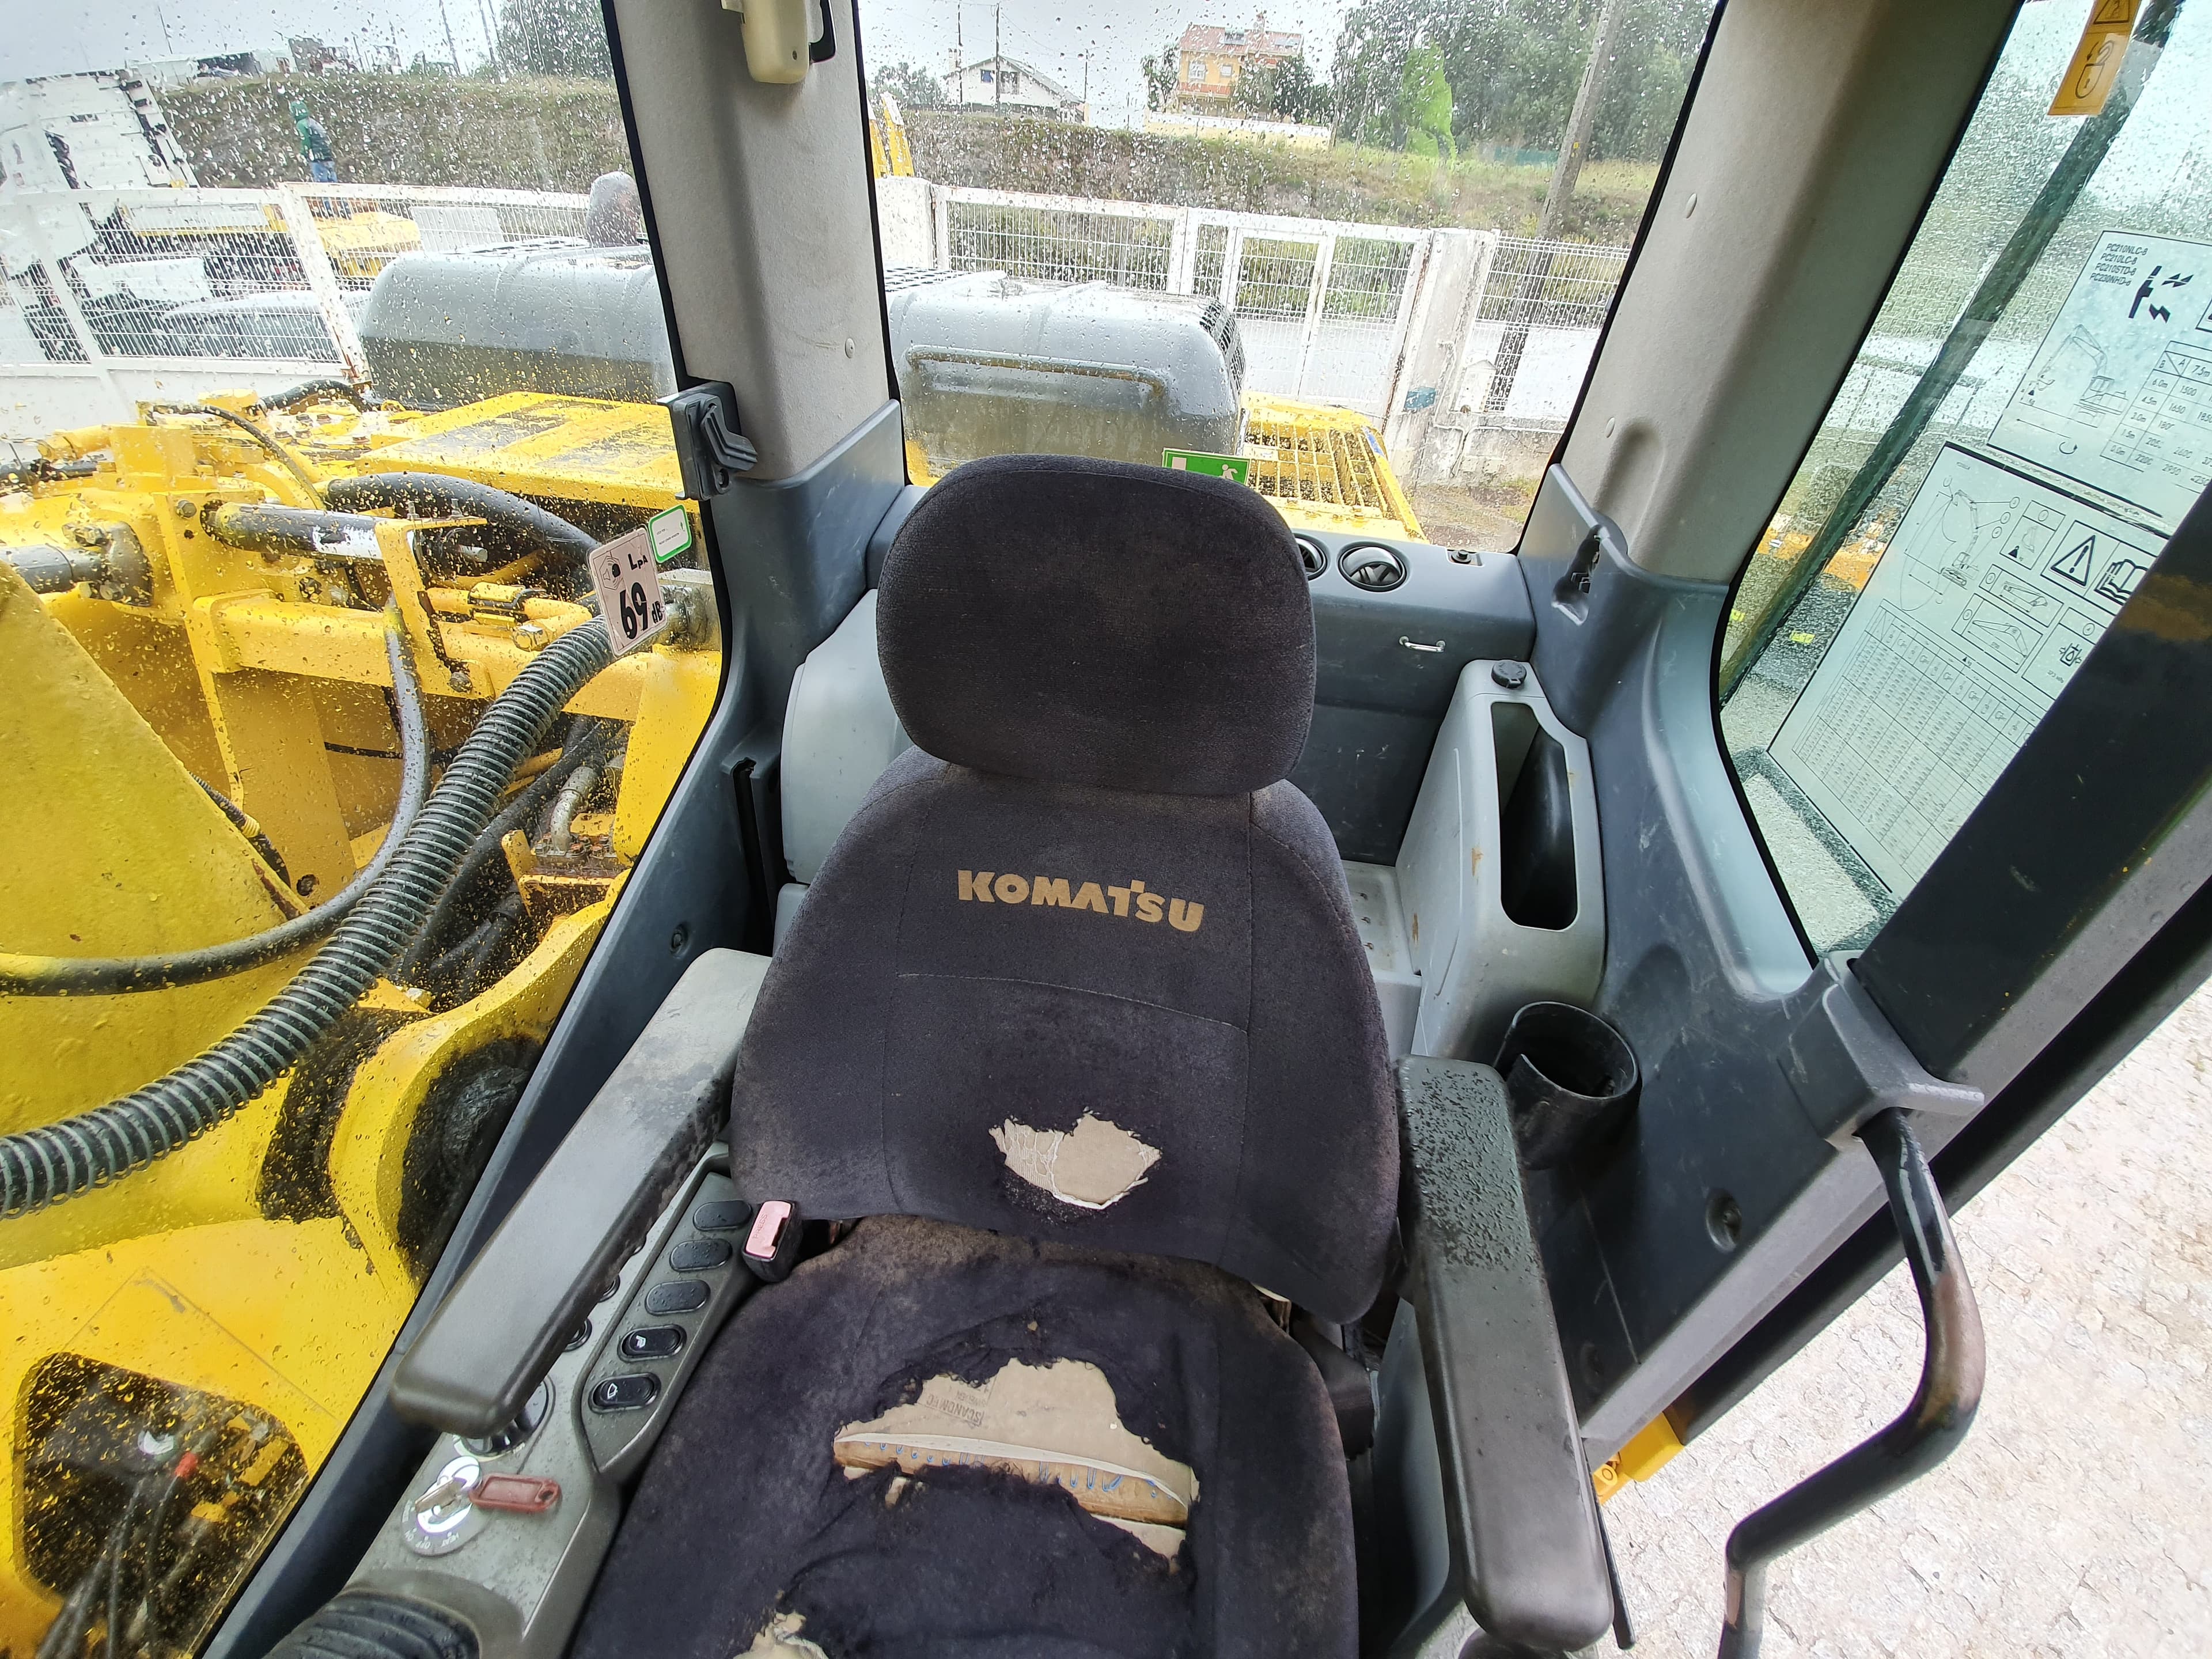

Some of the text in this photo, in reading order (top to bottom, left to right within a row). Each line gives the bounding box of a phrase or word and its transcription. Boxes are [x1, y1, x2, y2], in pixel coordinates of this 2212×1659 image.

[2105, 243, 2148, 255] PC210NLC-8
[2100, 253, 2138, 265] PC210LC-8
[2095, 263, 2137, 275] PC210STD-8
[2178, 359, 2186, 367] A
[2180, 385, 2197, 396] 1500
[2169, 403, 2186, 414] 1650
[619, 582, 663, 639] 69 dB
[957, 869, 1204, 932] KOMATSU
[752, 1213, 767, 1239] PRESS
